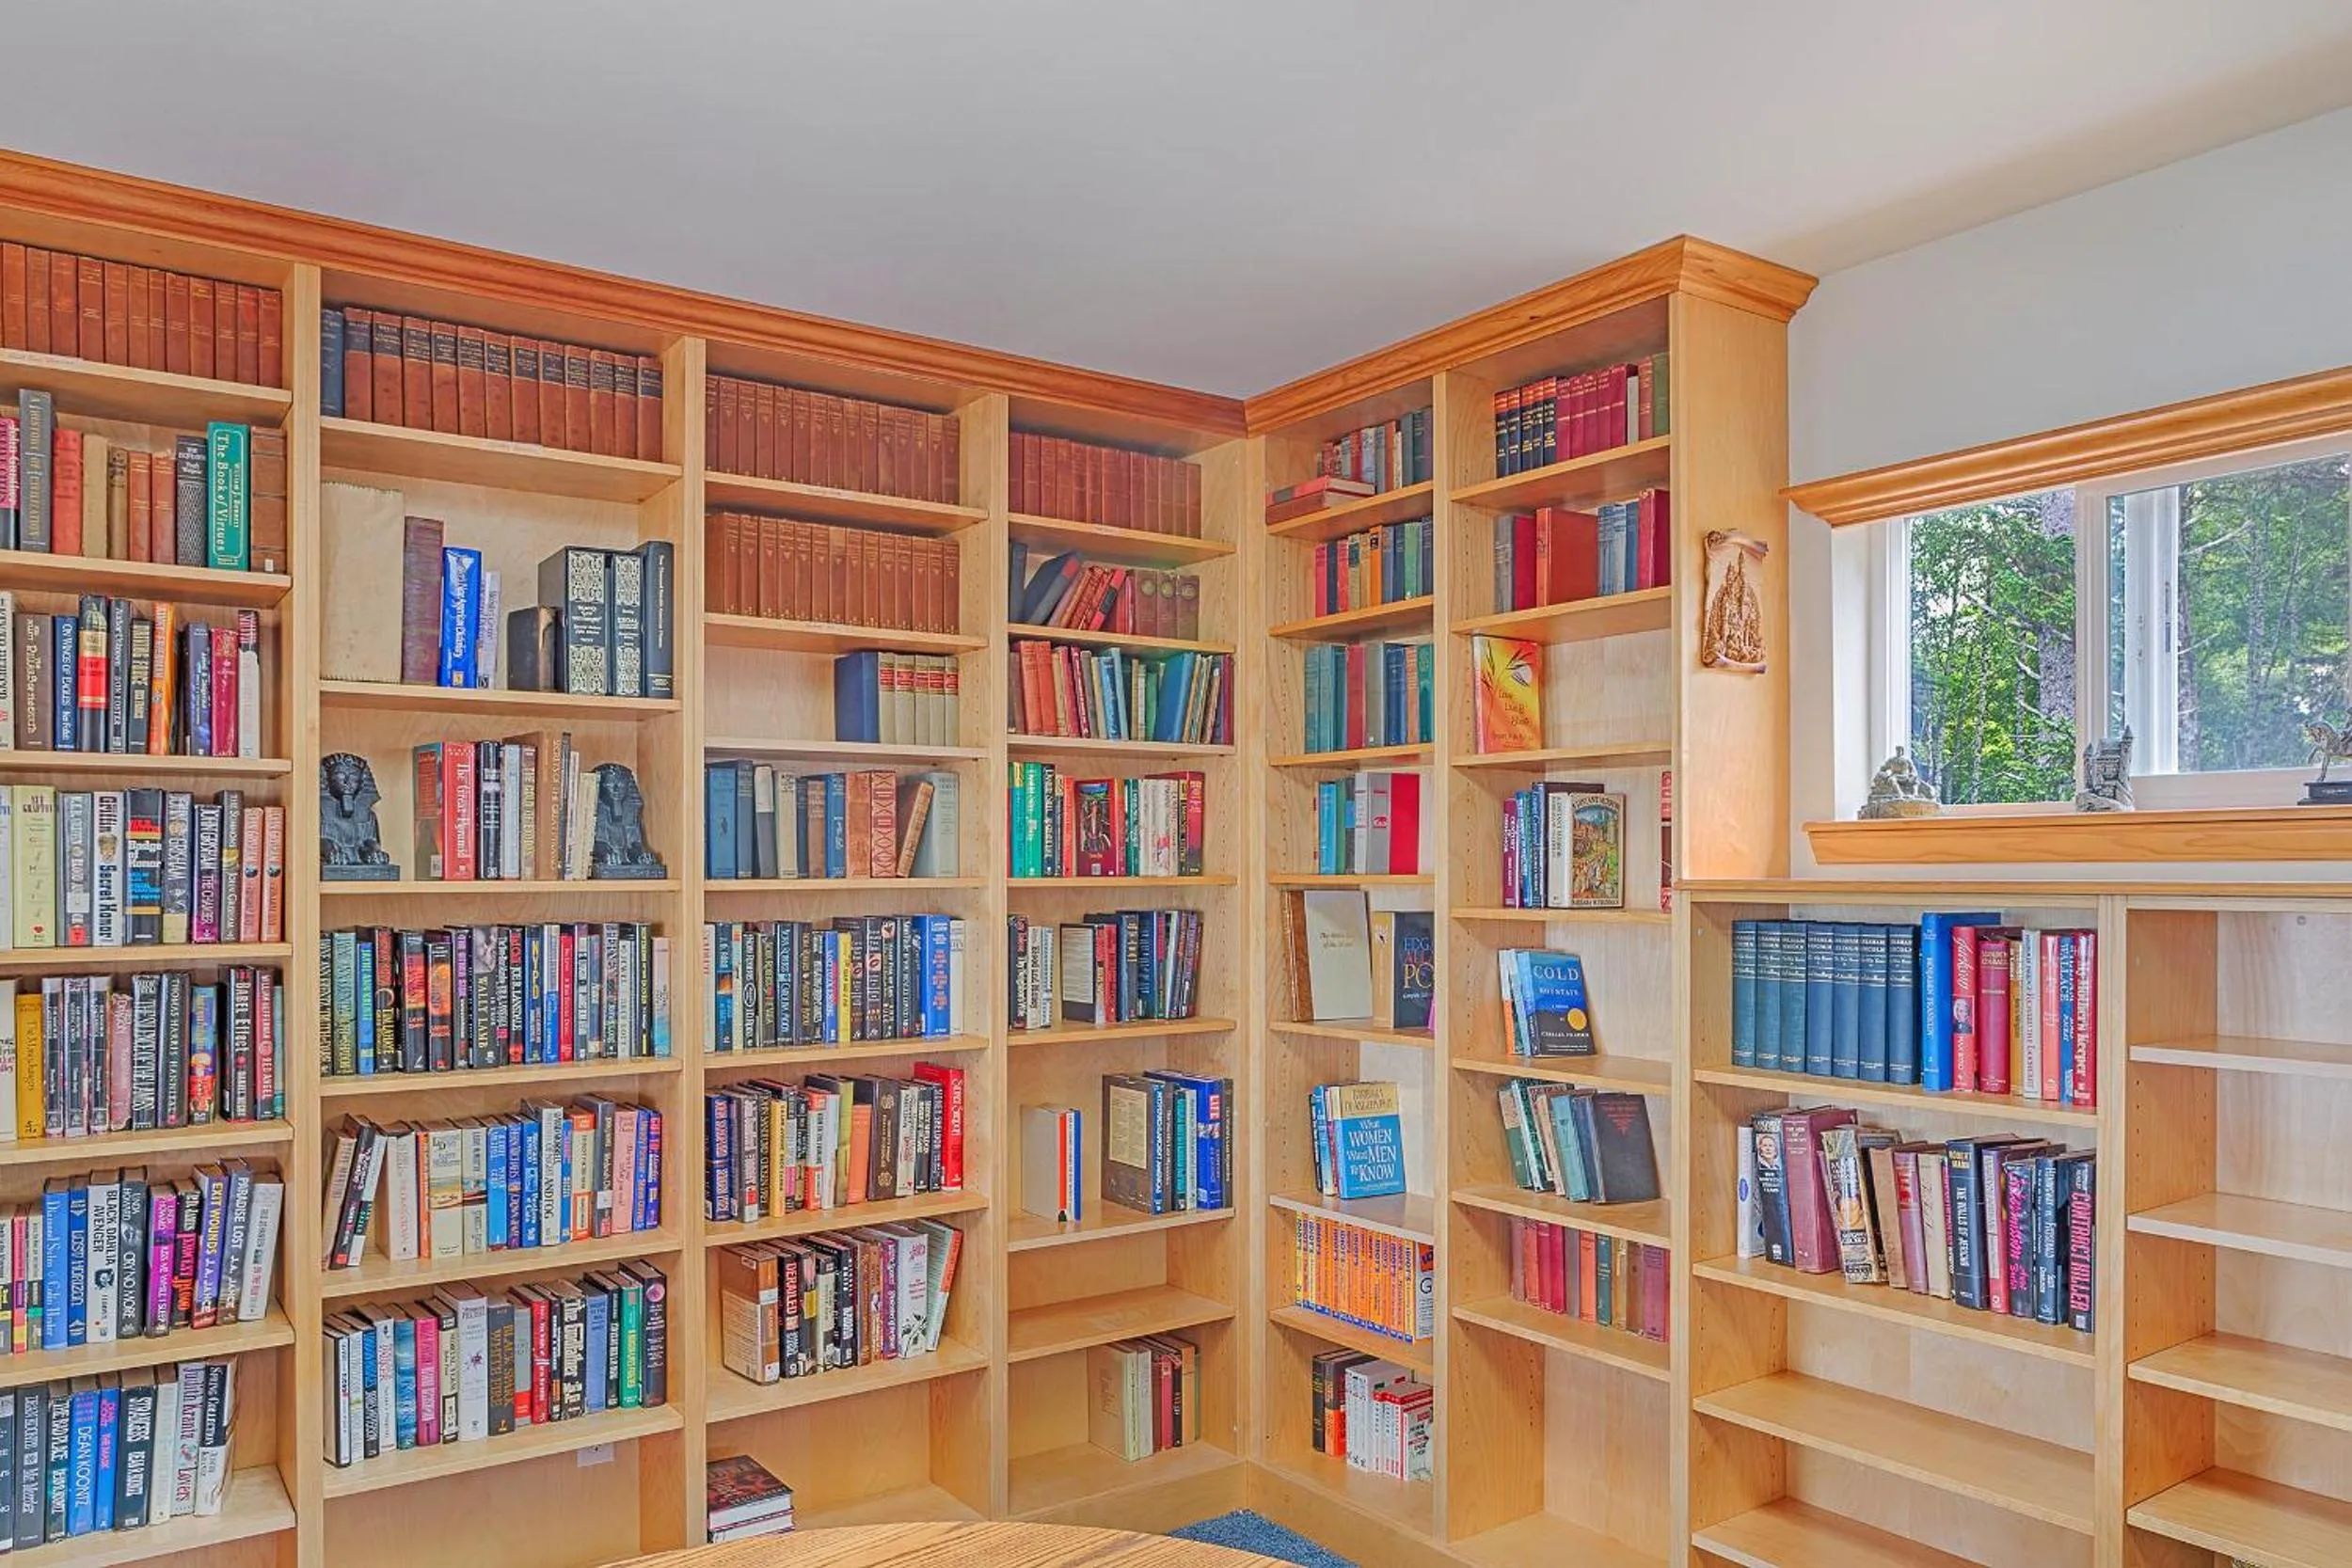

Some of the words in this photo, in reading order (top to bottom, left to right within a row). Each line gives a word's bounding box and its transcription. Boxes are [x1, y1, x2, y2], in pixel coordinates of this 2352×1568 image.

[216, 435, 230, 458] The
[216, 461, 230, 491] Book
[215, 495, 230, 506] of
[216, 508, 229, 551] Virtues
[99, 796, 117, 833] Griffin
[168, 795, 189, 820] JOHN
[200, 809, 219, 831] JOHN
[168, 837, 187, 880] GRISHAM
[200, 832, 219, 870] GRISHAM
[100, 865, 118, 901] Secret
[100, 904, 117, 938] Honor
[1534, 964, 1579, 981] COLD
[1953, 937, 1974, 990] Jackson
[2059, 942, 2069, 1002] WALLACE
[170, 978, 181, 1016] THOMAS
[234, 982, 248, 1012] BABEL
[478, 976, 488, 1014] WALLY
[169, 1020, 180, 1055] HARRIS
[478, 1018, 488, 1048] LAMB
[2074, 1034, 2090, 1076] Keeper
[1209, 1095, 1220, 1120] LIFE
[1348, 1129, 1392, 1148] WOMEN
[1367, 1146, 1396, 1164] MEN
[544, 1177, 554, 1196] AND
[1359, 1164, 1395, 1182] KNOW
[2044, 1167, 2056, 1205] HEMINGWAY
[105, 1191, 118, 1224] BLACK
[122, 1188, 132, 1221] HOWARD
[131, 1193, 140, 1214] LINDA
[210, 1181, 224, 1207] EXIT
[233, 1178, 248, 1223] PARADISE
[544, 1196, 553, 1219] FOG
[1957, 1187, 1967, 1199] THE
[92, 1205, 104, 1252] AVENGER
[1958, 1201, 1967, 1225] WALLS
[2008, 1172, 2030, 1260] Intermission
[2071, 1192, 2091, 1259] CONTRACT
[105, 1228, 117, 1266] DAHLIA
[206, 1209, 222, 1254] WOUNDS
[231, 1226, 245, 1249] LOST
[1958, 1227, 1968, 1237] OF
[2044, 1222, 2056, 1259] FITZGERALD
[123, 1251, 135, 1270] CRY
[204, 1259, 215, 1277] J.A.
[1959, 1238, 1970, 1267] JERICHO
[123, 1270, 135, 1289] NO
[786, 1261, 799, 1314] DERAILED
[2071, 1261, 2091, 1311] KILLER
[123, 1290, 135, 1319] MORE
[564, 1303, 584, 1322] The
[182, 1367, 203, 1401] Judith
[180, 1404, 201, 1440] Krantz
[76, 1427, 92, 1459] DEAN
[74, 1461, 91, 1508] KOONTZ
[175, 1467, 194, 1502] Lovers
